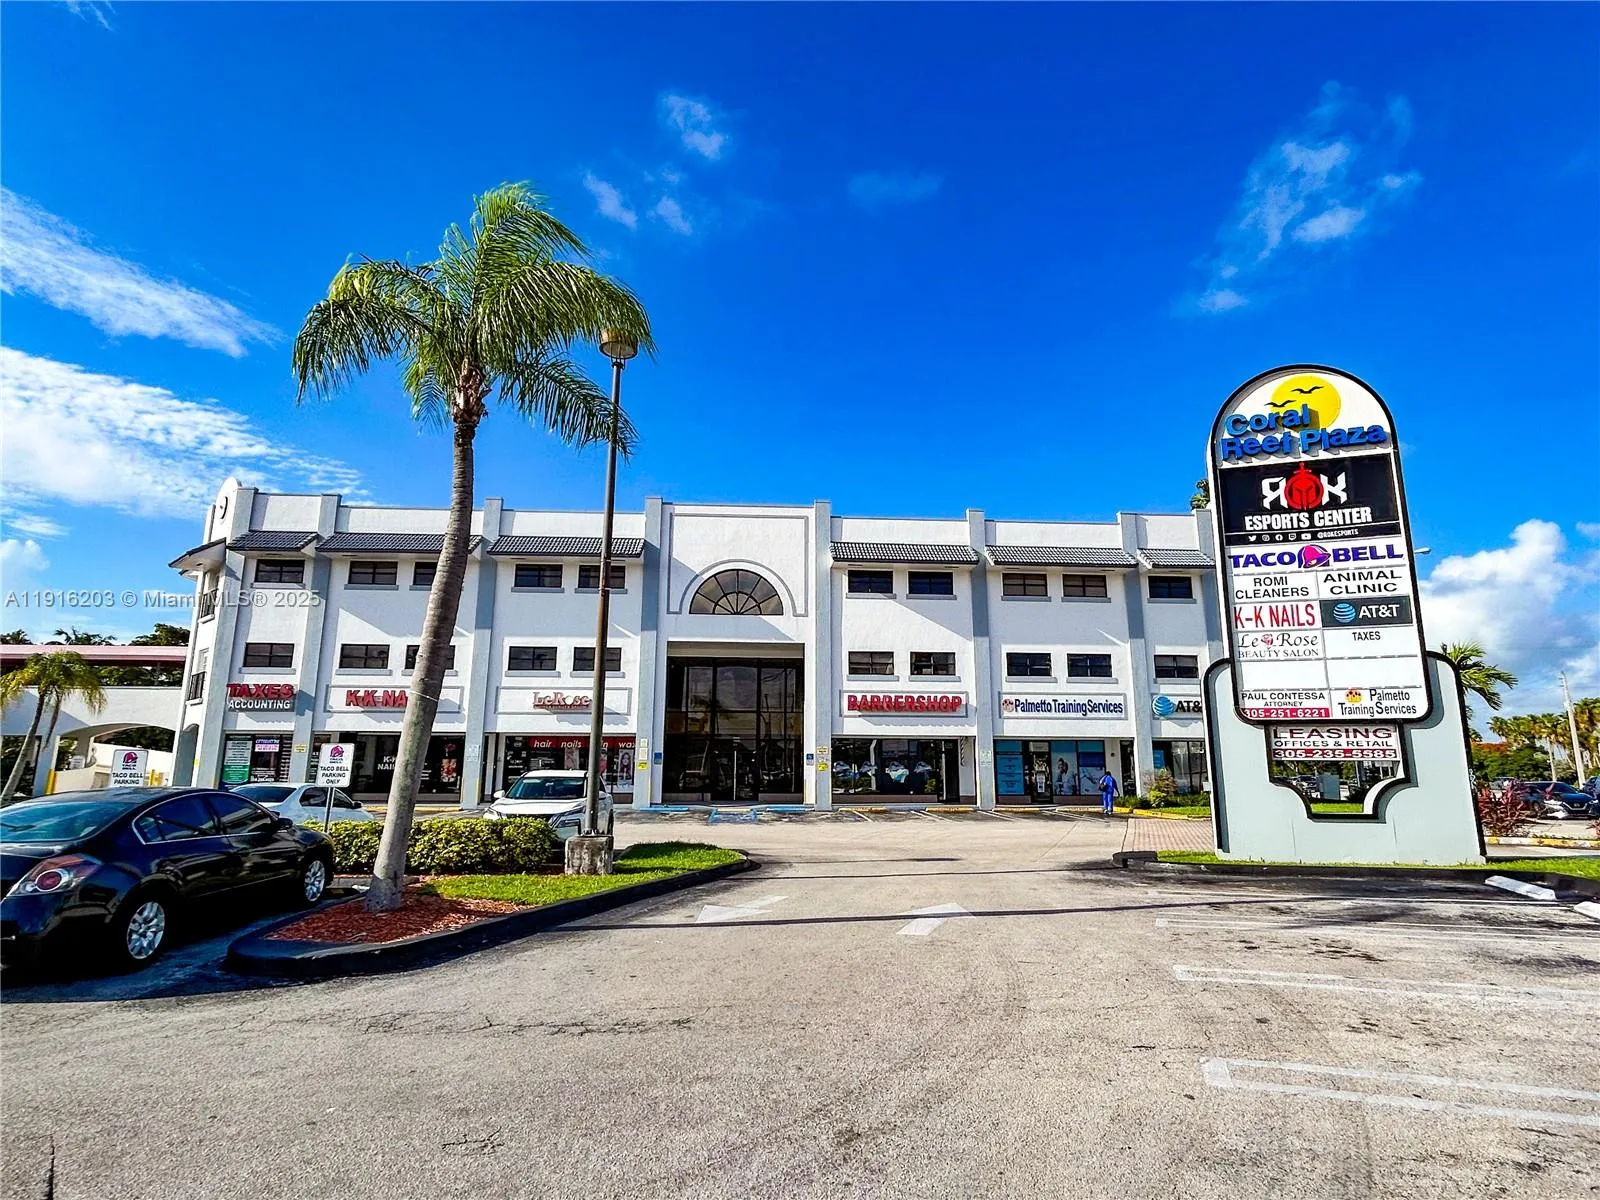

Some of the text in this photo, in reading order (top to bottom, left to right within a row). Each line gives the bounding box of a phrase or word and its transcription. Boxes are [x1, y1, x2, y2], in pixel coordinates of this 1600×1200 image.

[1225, 404, 1311, 436] Coral
[1221, 425, 1387, 460] Reef Plaza
[1245, 506, 1373, 531] ESPORTS CENTER
[1228, 544, 1404, 568] TACO BELL
[1253, 576, 1288, 587] ROMI
[1323, 569, 1402, 583] ANIMAL
[1235, 587, 1310, 600] CLEANERS
[1329, 582, 1398, 595] CLINIC
[1234, 604, 1316, 629] K-K NAILS
[1359, 604, 1400, 619] AT&T
[1238, 632, 1319, 648] Le Rose
[1352, 631, 1381, 641] TAXES
[1238, 648, 1319, 659] BEAUTY SALON
[226, 683, 295, 699] TAXES
[1241, 691, 1326, 700] PAUL CONTESSA
[1369, 689, 1411, 702] Palmetto
[228, 700, 291, 709] ACCOUNTING
[847, 694, 962, 712] BARBERSHOP
[1014, 698, 1124, 716] Palmetto Training Services
[1175, 700, 1202, 713] AT&
[1338, 702, 1417, 717] Training Services
[1273, 728, 1392, 740] LEASING
[533, 740, 552, 748] hair
[561, 740, 582, 748] nails
[1274, 749, 1396, 759] 305-235-5585
